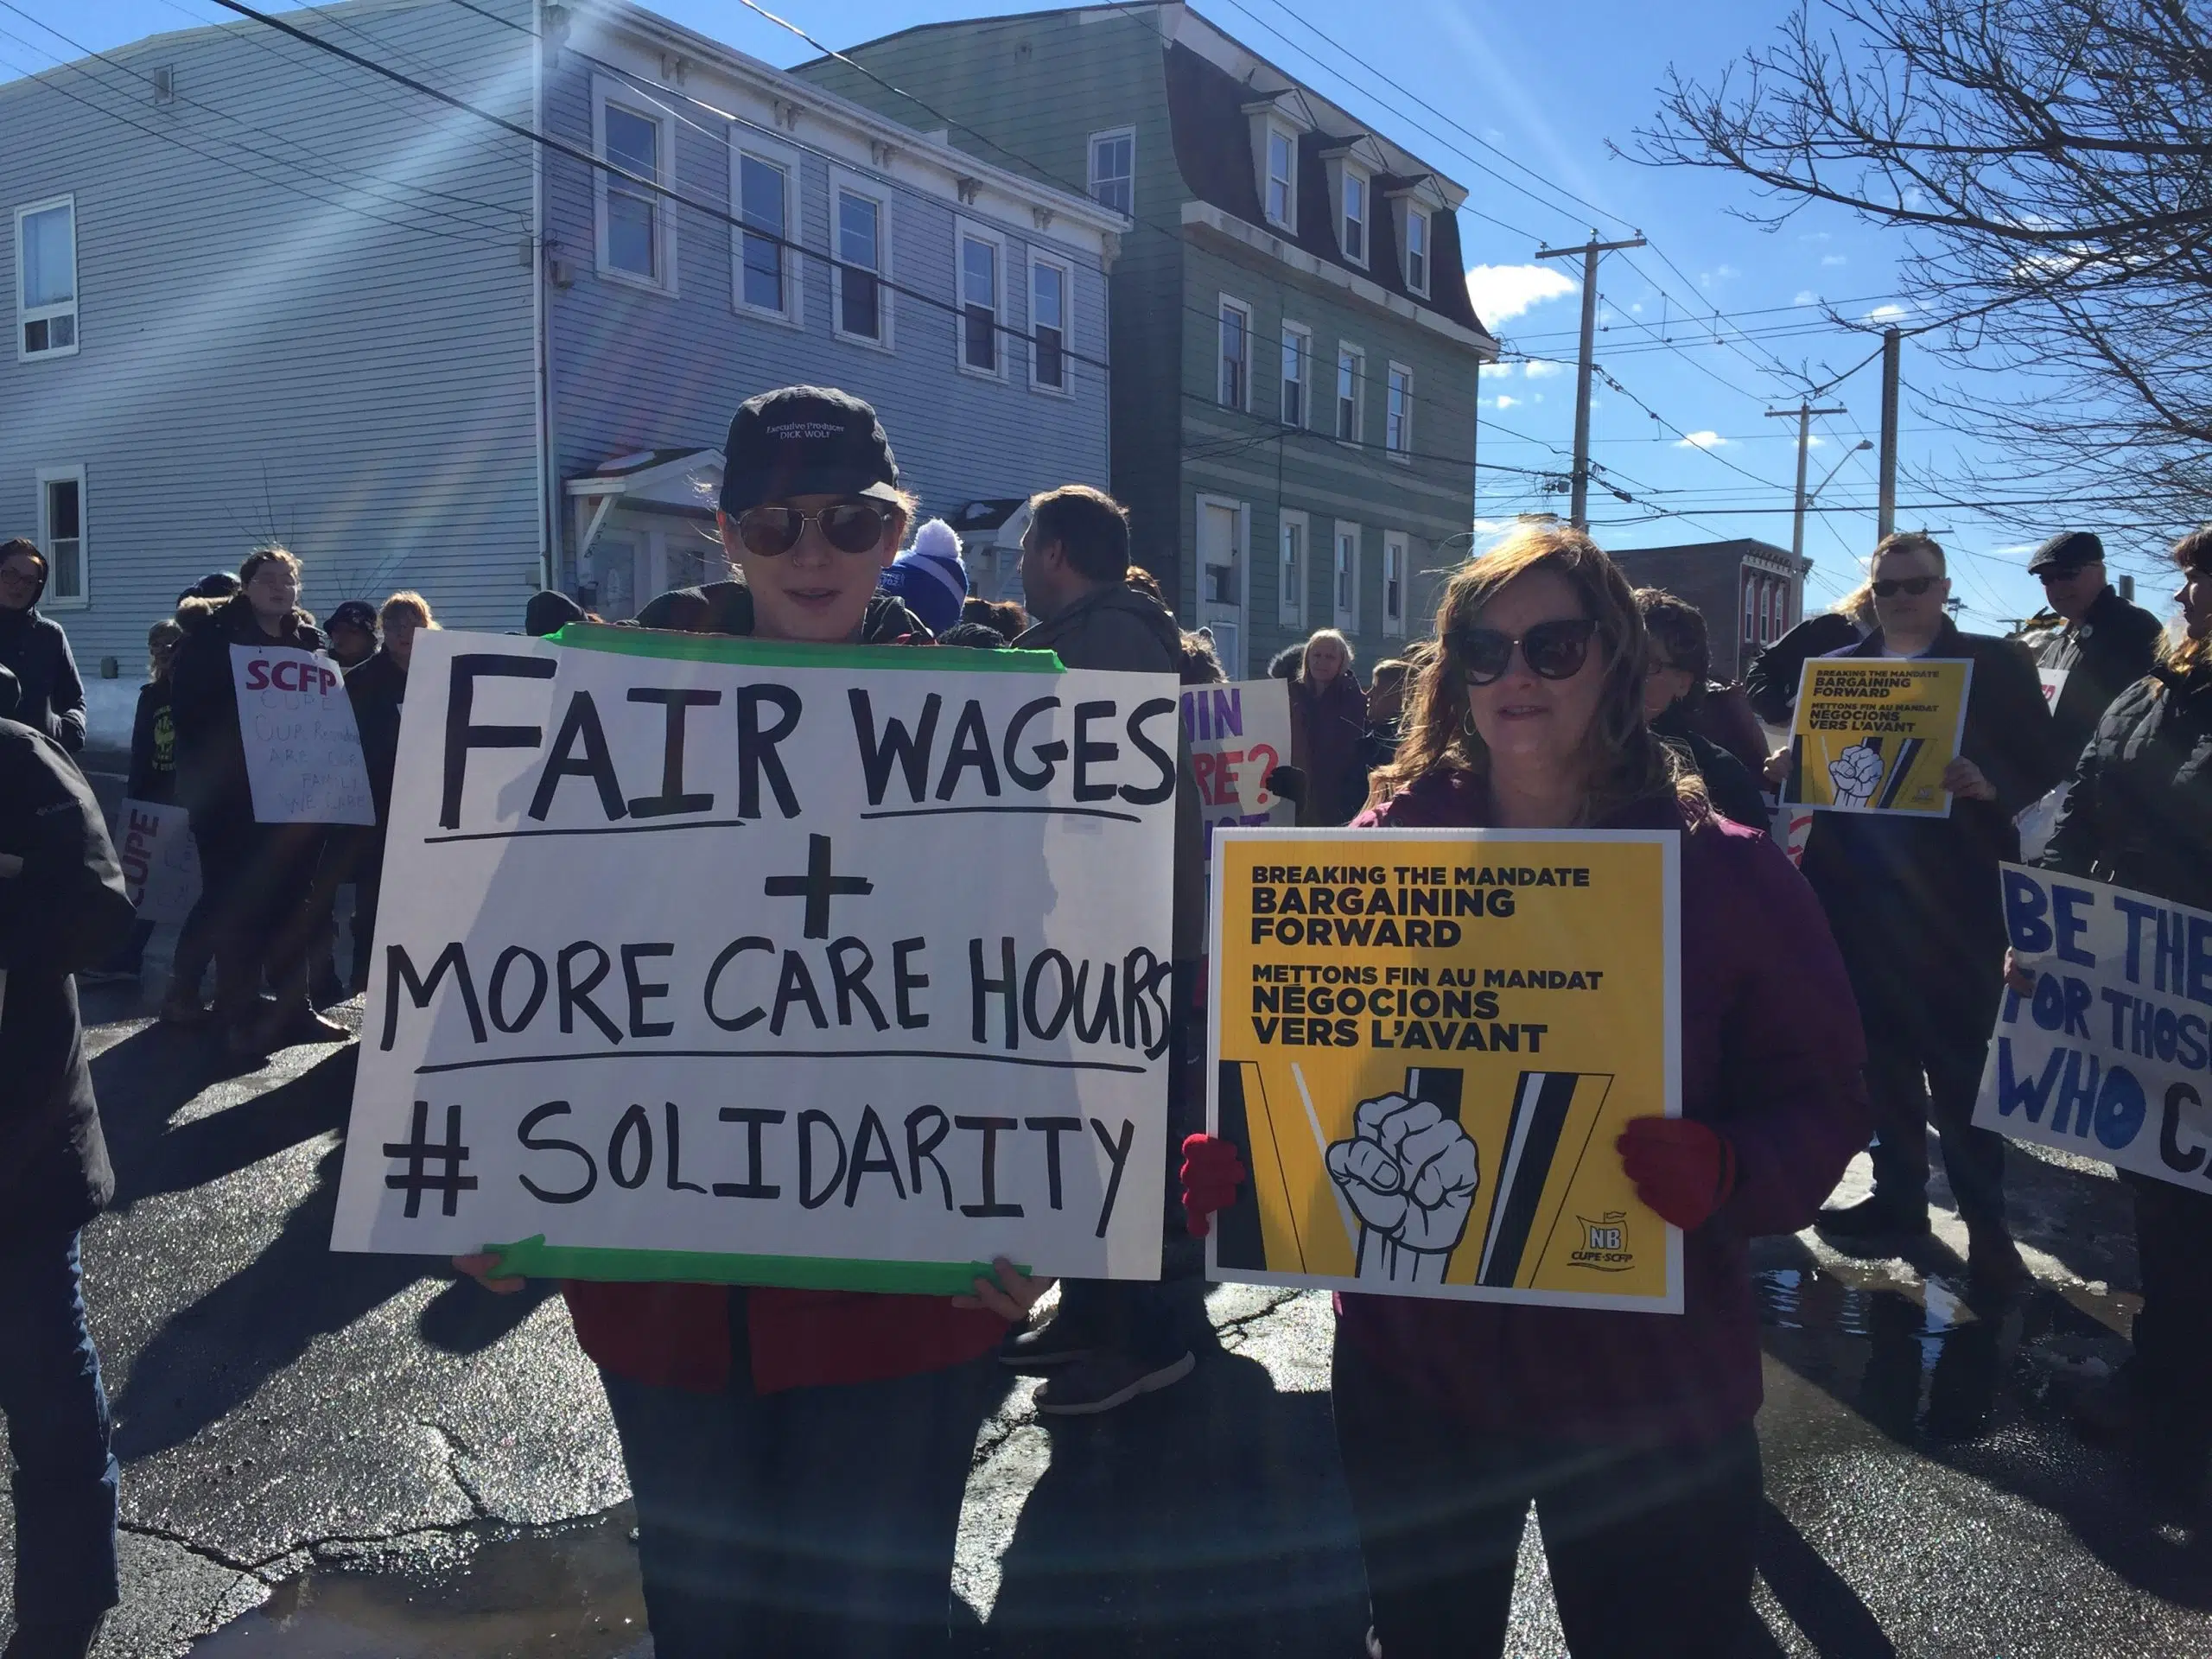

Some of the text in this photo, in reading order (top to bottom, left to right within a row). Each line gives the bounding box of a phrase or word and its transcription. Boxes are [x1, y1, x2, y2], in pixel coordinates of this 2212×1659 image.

[246, 659, 337, 696] SCFP
[1813, 687, 1891, 698] FORWARD
[1815, 677, 1910, 688] BARGAINING
[261, 690, 336, 710] CUPE
[439, 654, 1176, 830] FAIR WAGES
[1809, 720, 1916, 733] VERS L'AVANT
[764, 834, 874, 938] +
[1252, 866, 1590, 887] BREAKING THE MANDATE
[1252, 887, 1516, 918] BARGAINING
[1252, 918, 1462, 948] FORWARD
[2002, 869, 2096, 969] BE
[1253, 964, 1604, 990] METTONS FIN AU MANDAT
[379, 936, 1172, 1061] MORE CARE HOURS
[1251, 1016, 1548, 1053] VERS L'AVANT
[2101, 986, 2212, 1076] THOS
[1998, 1036, 2212, 1179] WHO C
[1590, 1225, 1621, 1250] NB
